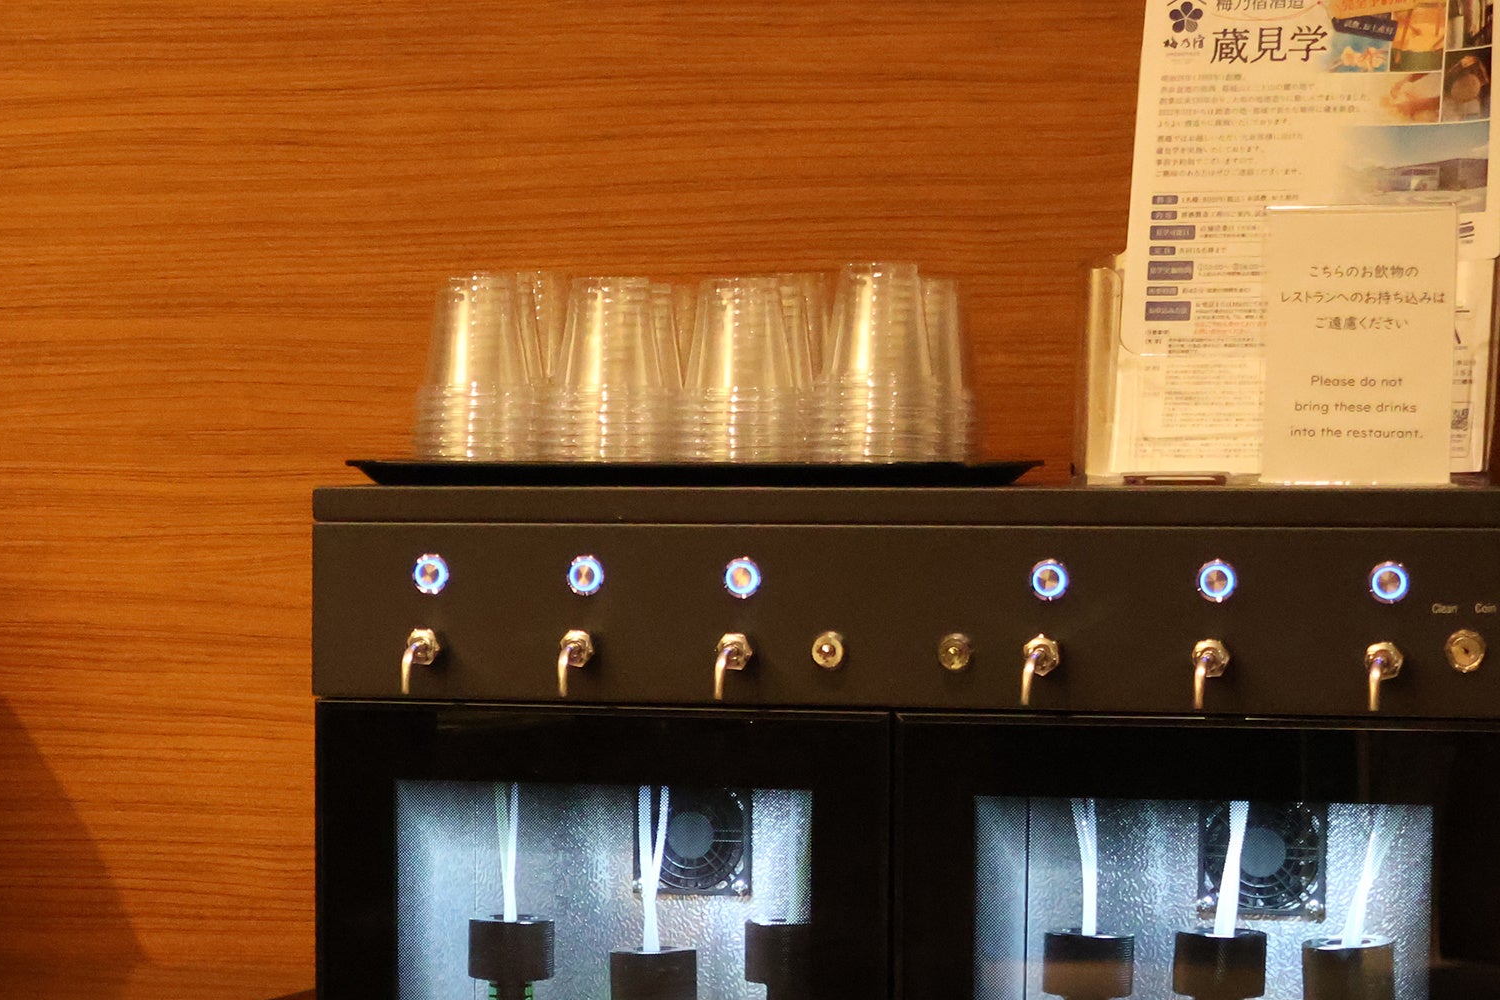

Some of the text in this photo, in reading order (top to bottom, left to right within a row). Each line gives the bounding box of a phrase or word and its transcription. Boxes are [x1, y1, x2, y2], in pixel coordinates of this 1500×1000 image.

[1210, 25, 1328, 64] 蔵見学
[1309, 265, 1419, 279] こちらのお飲物の
[1281, 291, 1445, 305] レストランへのお持ち込みは
[1315, 316, 1408, 330] ご遠慮ください
[1310, 375, 1403, 387] Please do not
[1295, 402, 1417, 415] bring these drinks
[1290, 426, 1423, 439] into the restaurant.
